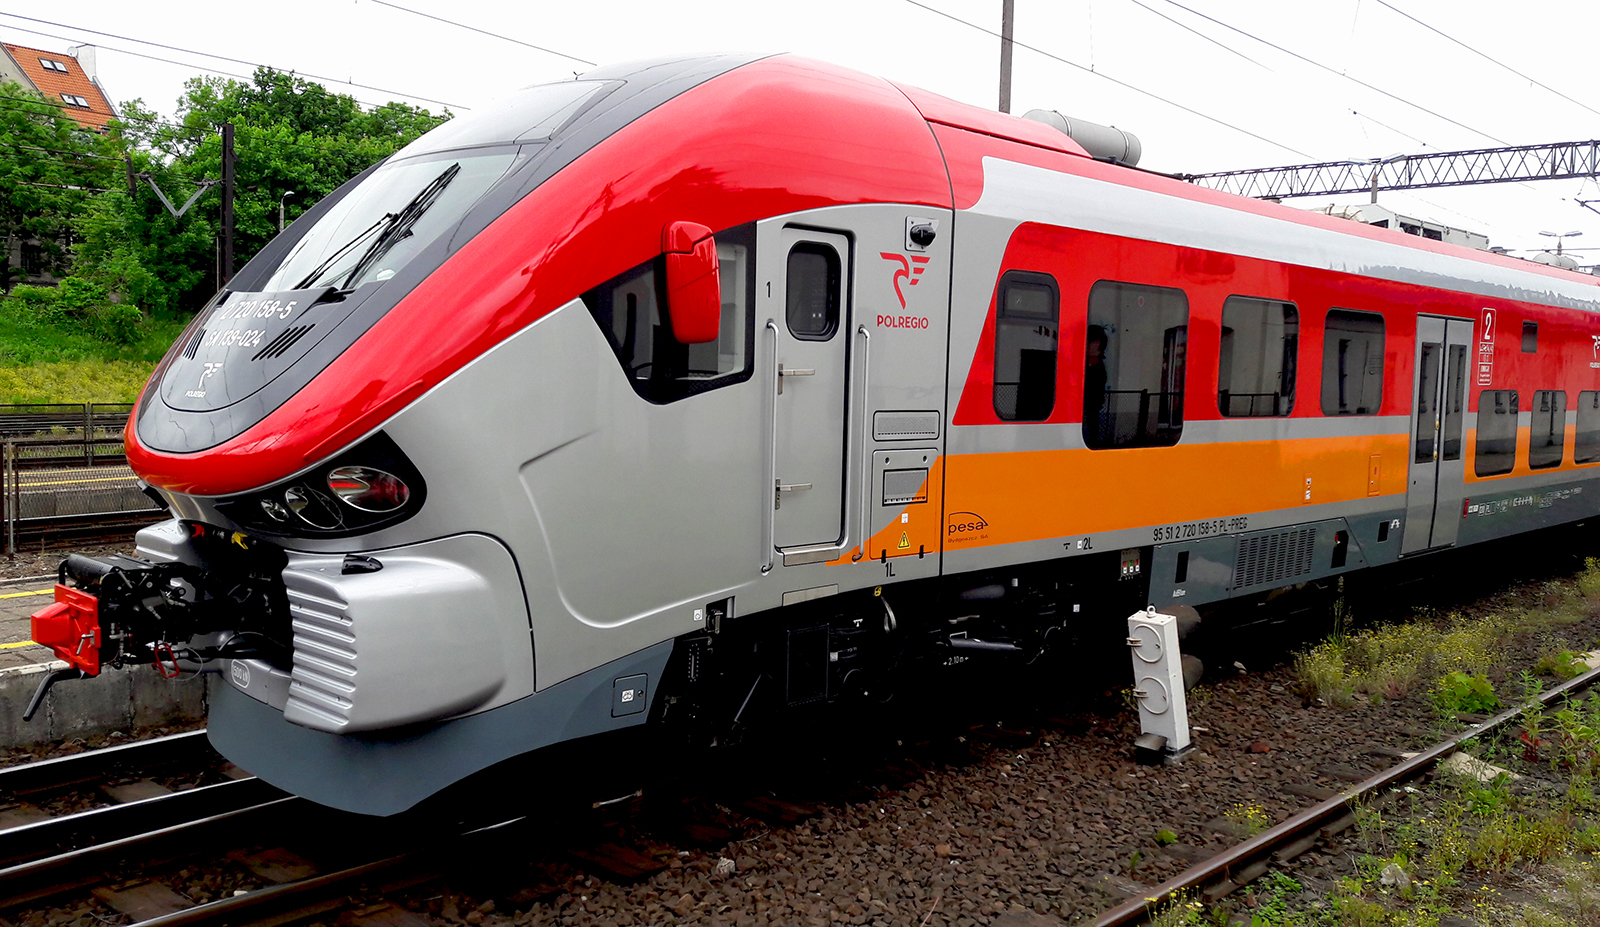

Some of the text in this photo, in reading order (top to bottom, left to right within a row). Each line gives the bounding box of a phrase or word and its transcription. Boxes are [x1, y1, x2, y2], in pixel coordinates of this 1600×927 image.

[766, 281, 771, 298] 1
[228, 300, 258, 319] 720
[252, 300, 298, 320] 158-5
[877, 315, 929, 329] POLREGIO
[1484, 312, 1492, 340] 2
[205, 329, 266, 348] SA 139-024
[948, 521, 984, 536] pesa
[1153, 516, 1249, 541] 95 51 2 720 158-5 PL-PREG
[1083, 537, 1093, 550] 2L
[885, 562, 896, 577] 1L
